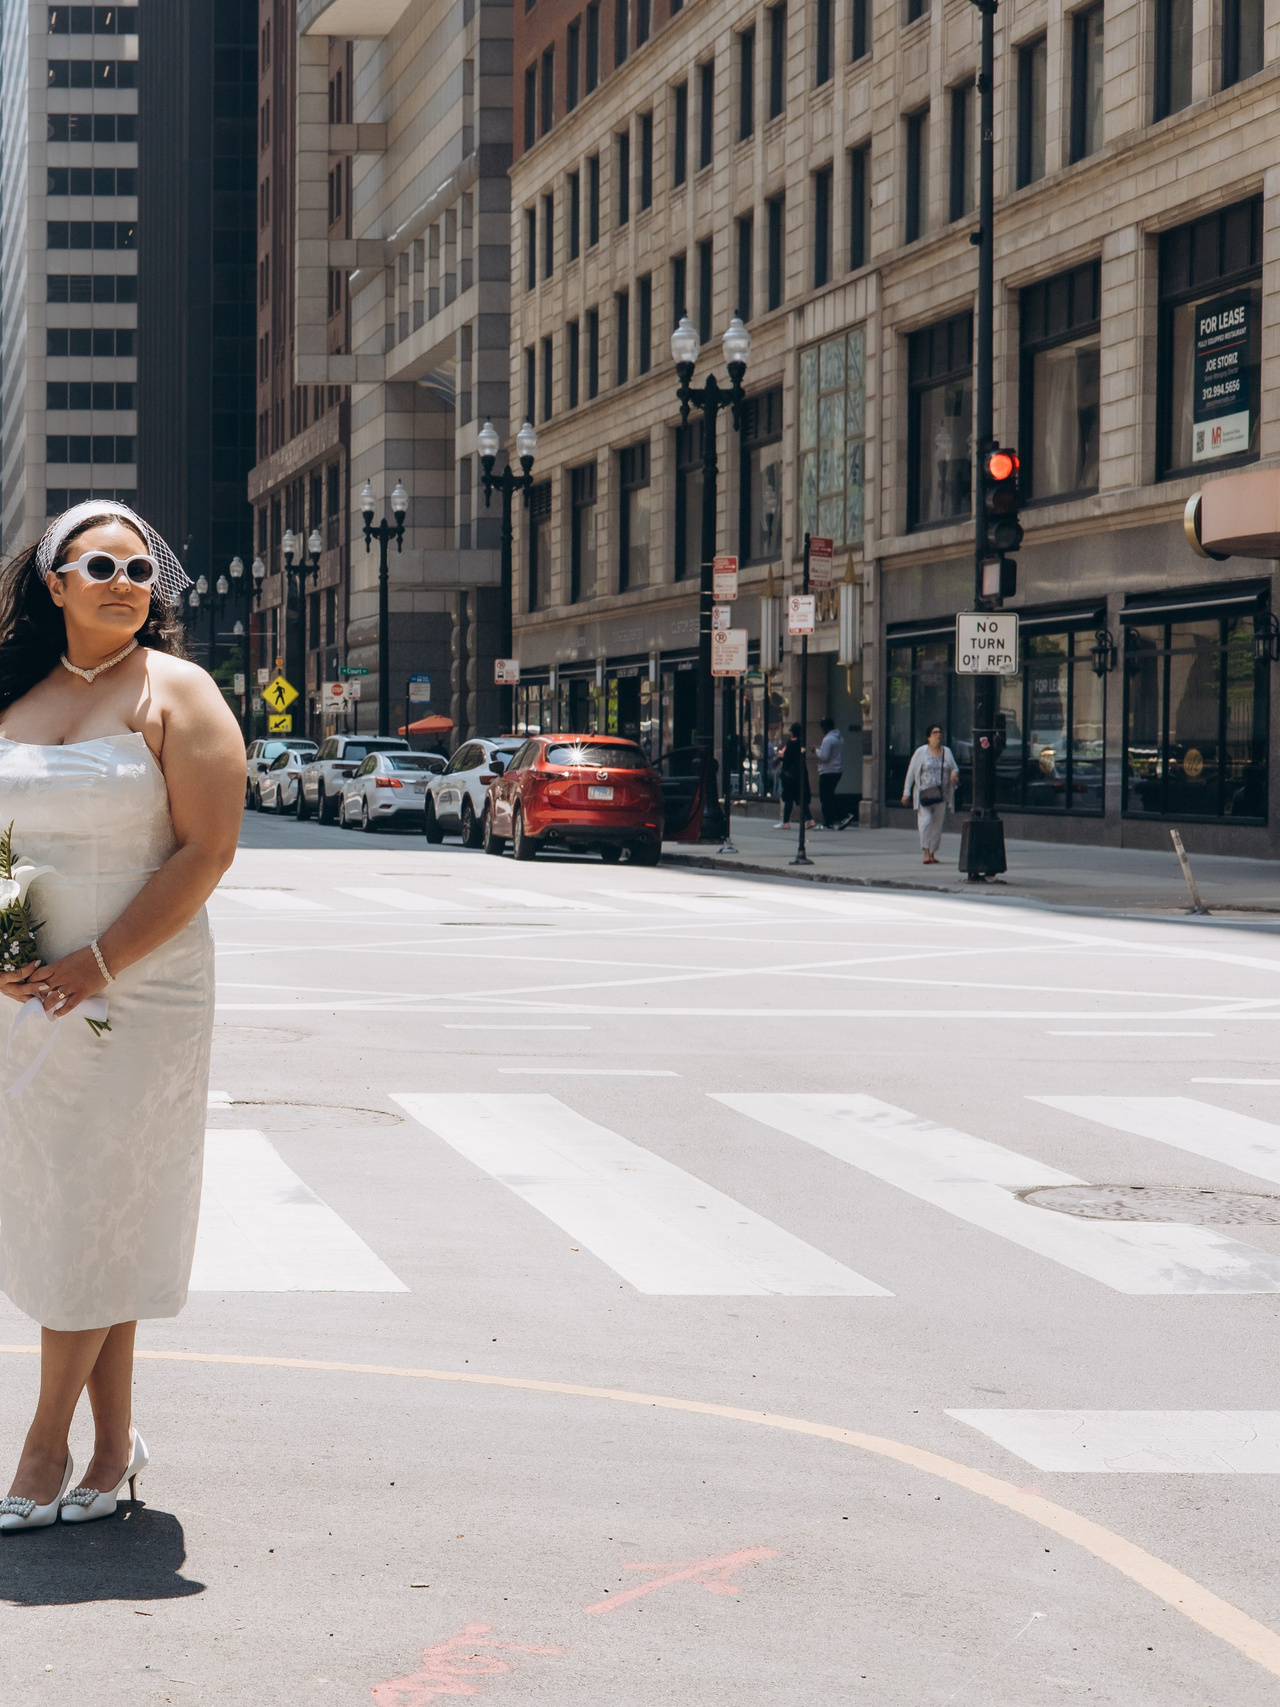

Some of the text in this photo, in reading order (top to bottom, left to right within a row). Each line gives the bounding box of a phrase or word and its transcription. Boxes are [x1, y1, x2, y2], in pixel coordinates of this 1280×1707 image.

[1200, 306, 1245, 336] FOR LEASE
[1205, 351, 1238, 372] JOE STORIZ
[1202, 379, 1241, 400] 312.994.5656
[976, 621, 999, 633] NO
[970, 637, 1005, 650] TURN
